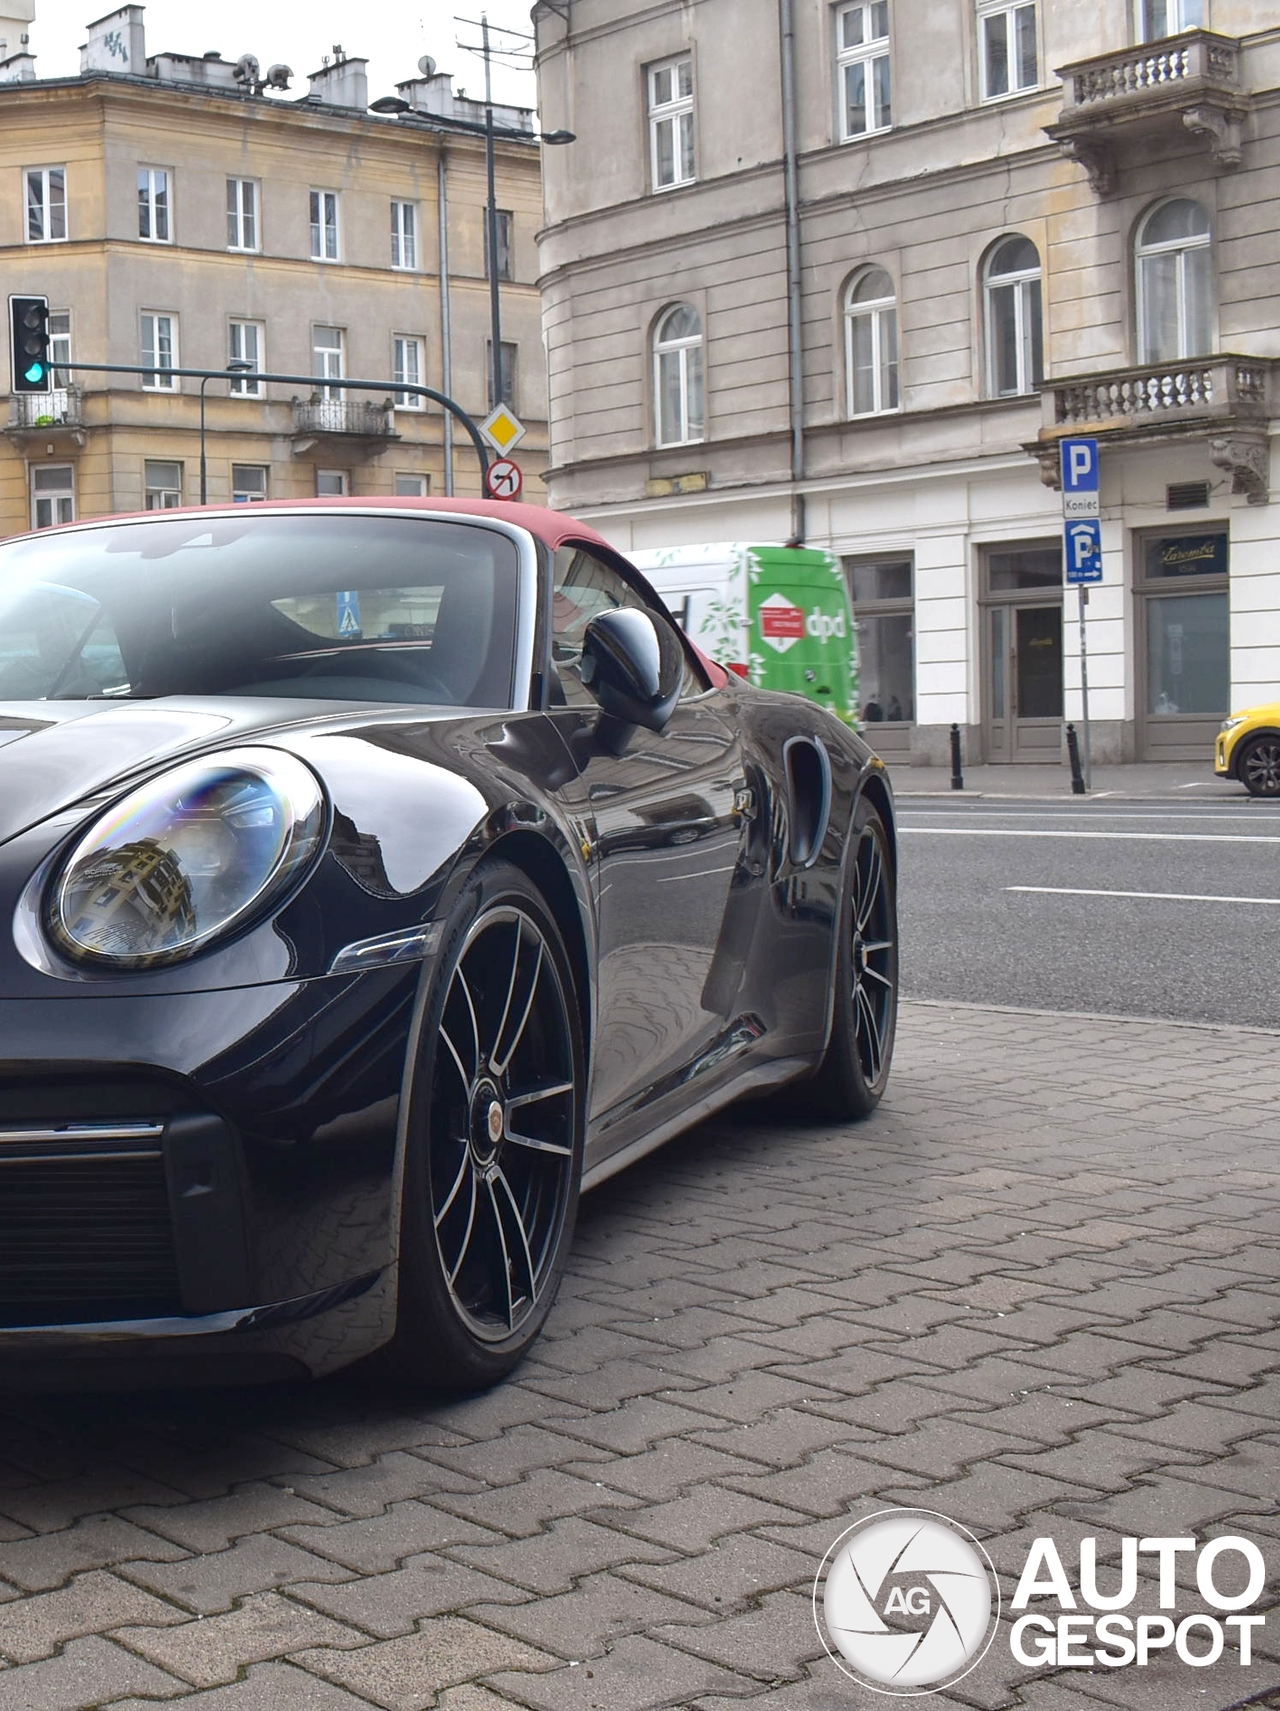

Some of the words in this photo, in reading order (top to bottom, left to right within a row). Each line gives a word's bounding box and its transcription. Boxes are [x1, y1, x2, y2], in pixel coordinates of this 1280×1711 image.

[1070, 445, 1091, 486] P
[1066, 500, 1097, 511] Koniec
[1074, 535, 1093, 568] P
[806, 606, 847, 644] dpd
